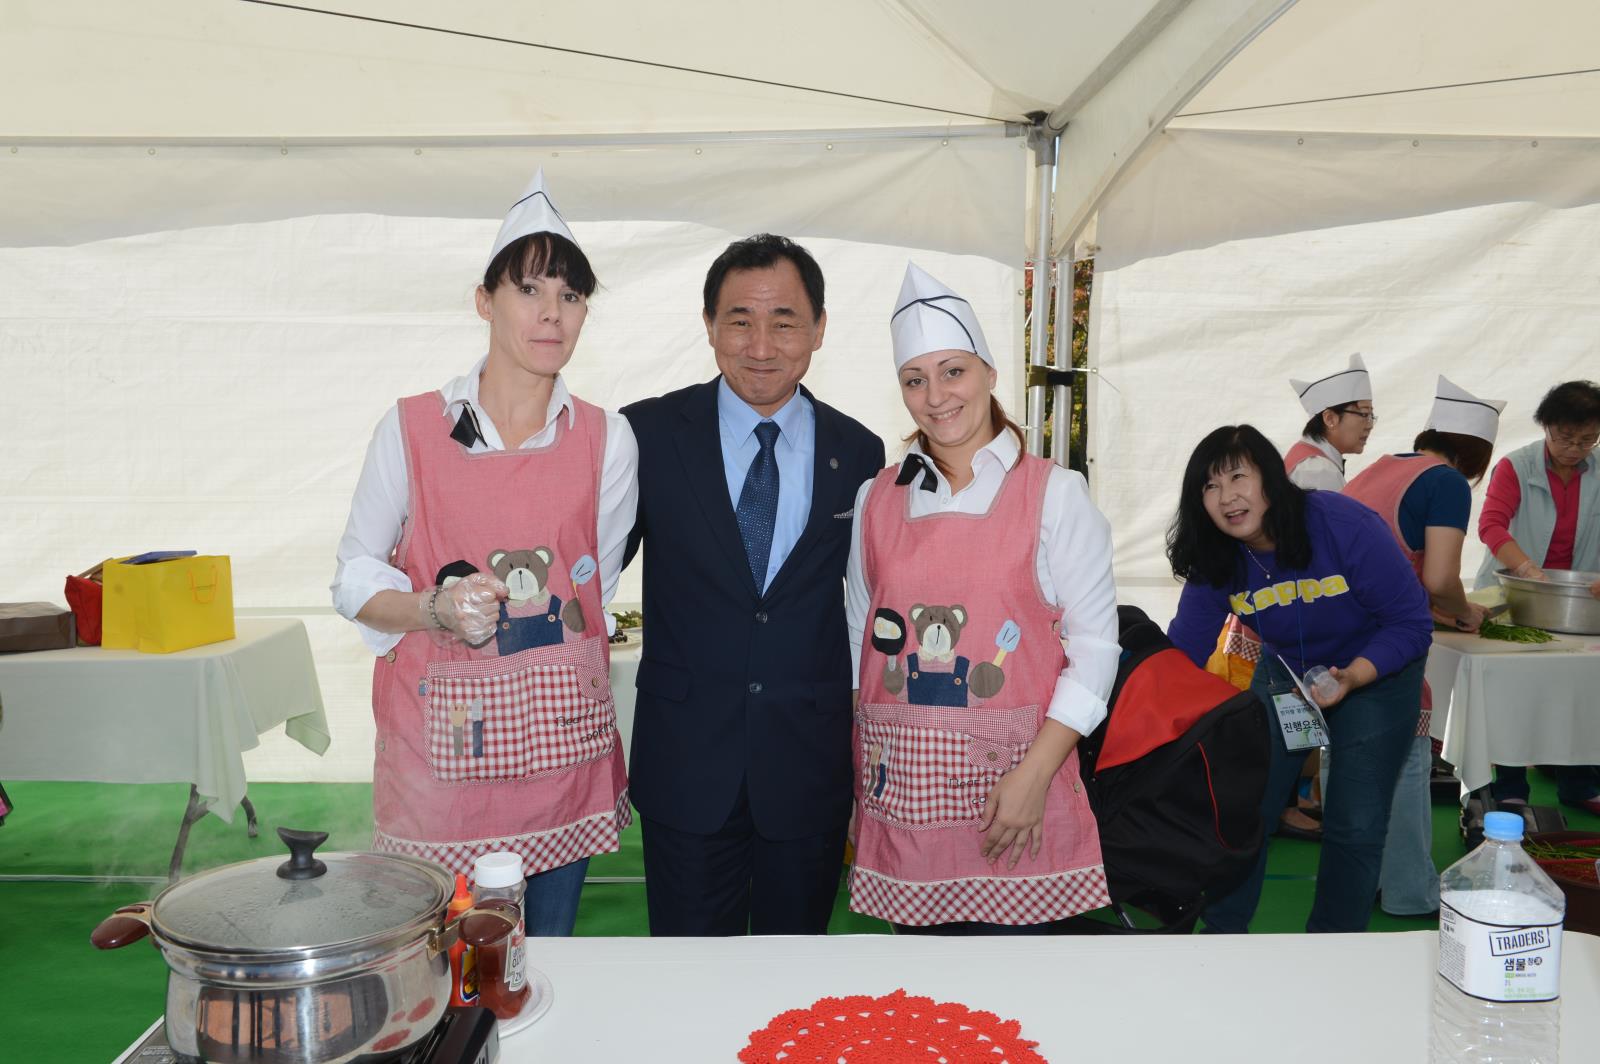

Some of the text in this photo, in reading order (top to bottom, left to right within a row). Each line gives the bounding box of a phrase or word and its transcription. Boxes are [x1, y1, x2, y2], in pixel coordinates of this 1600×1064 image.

[1229, 575, 1349, 616] Kappa
[1283, 719, 1321, 734] 진행요원
[1495, 929, 1545, 951] TRADERS
